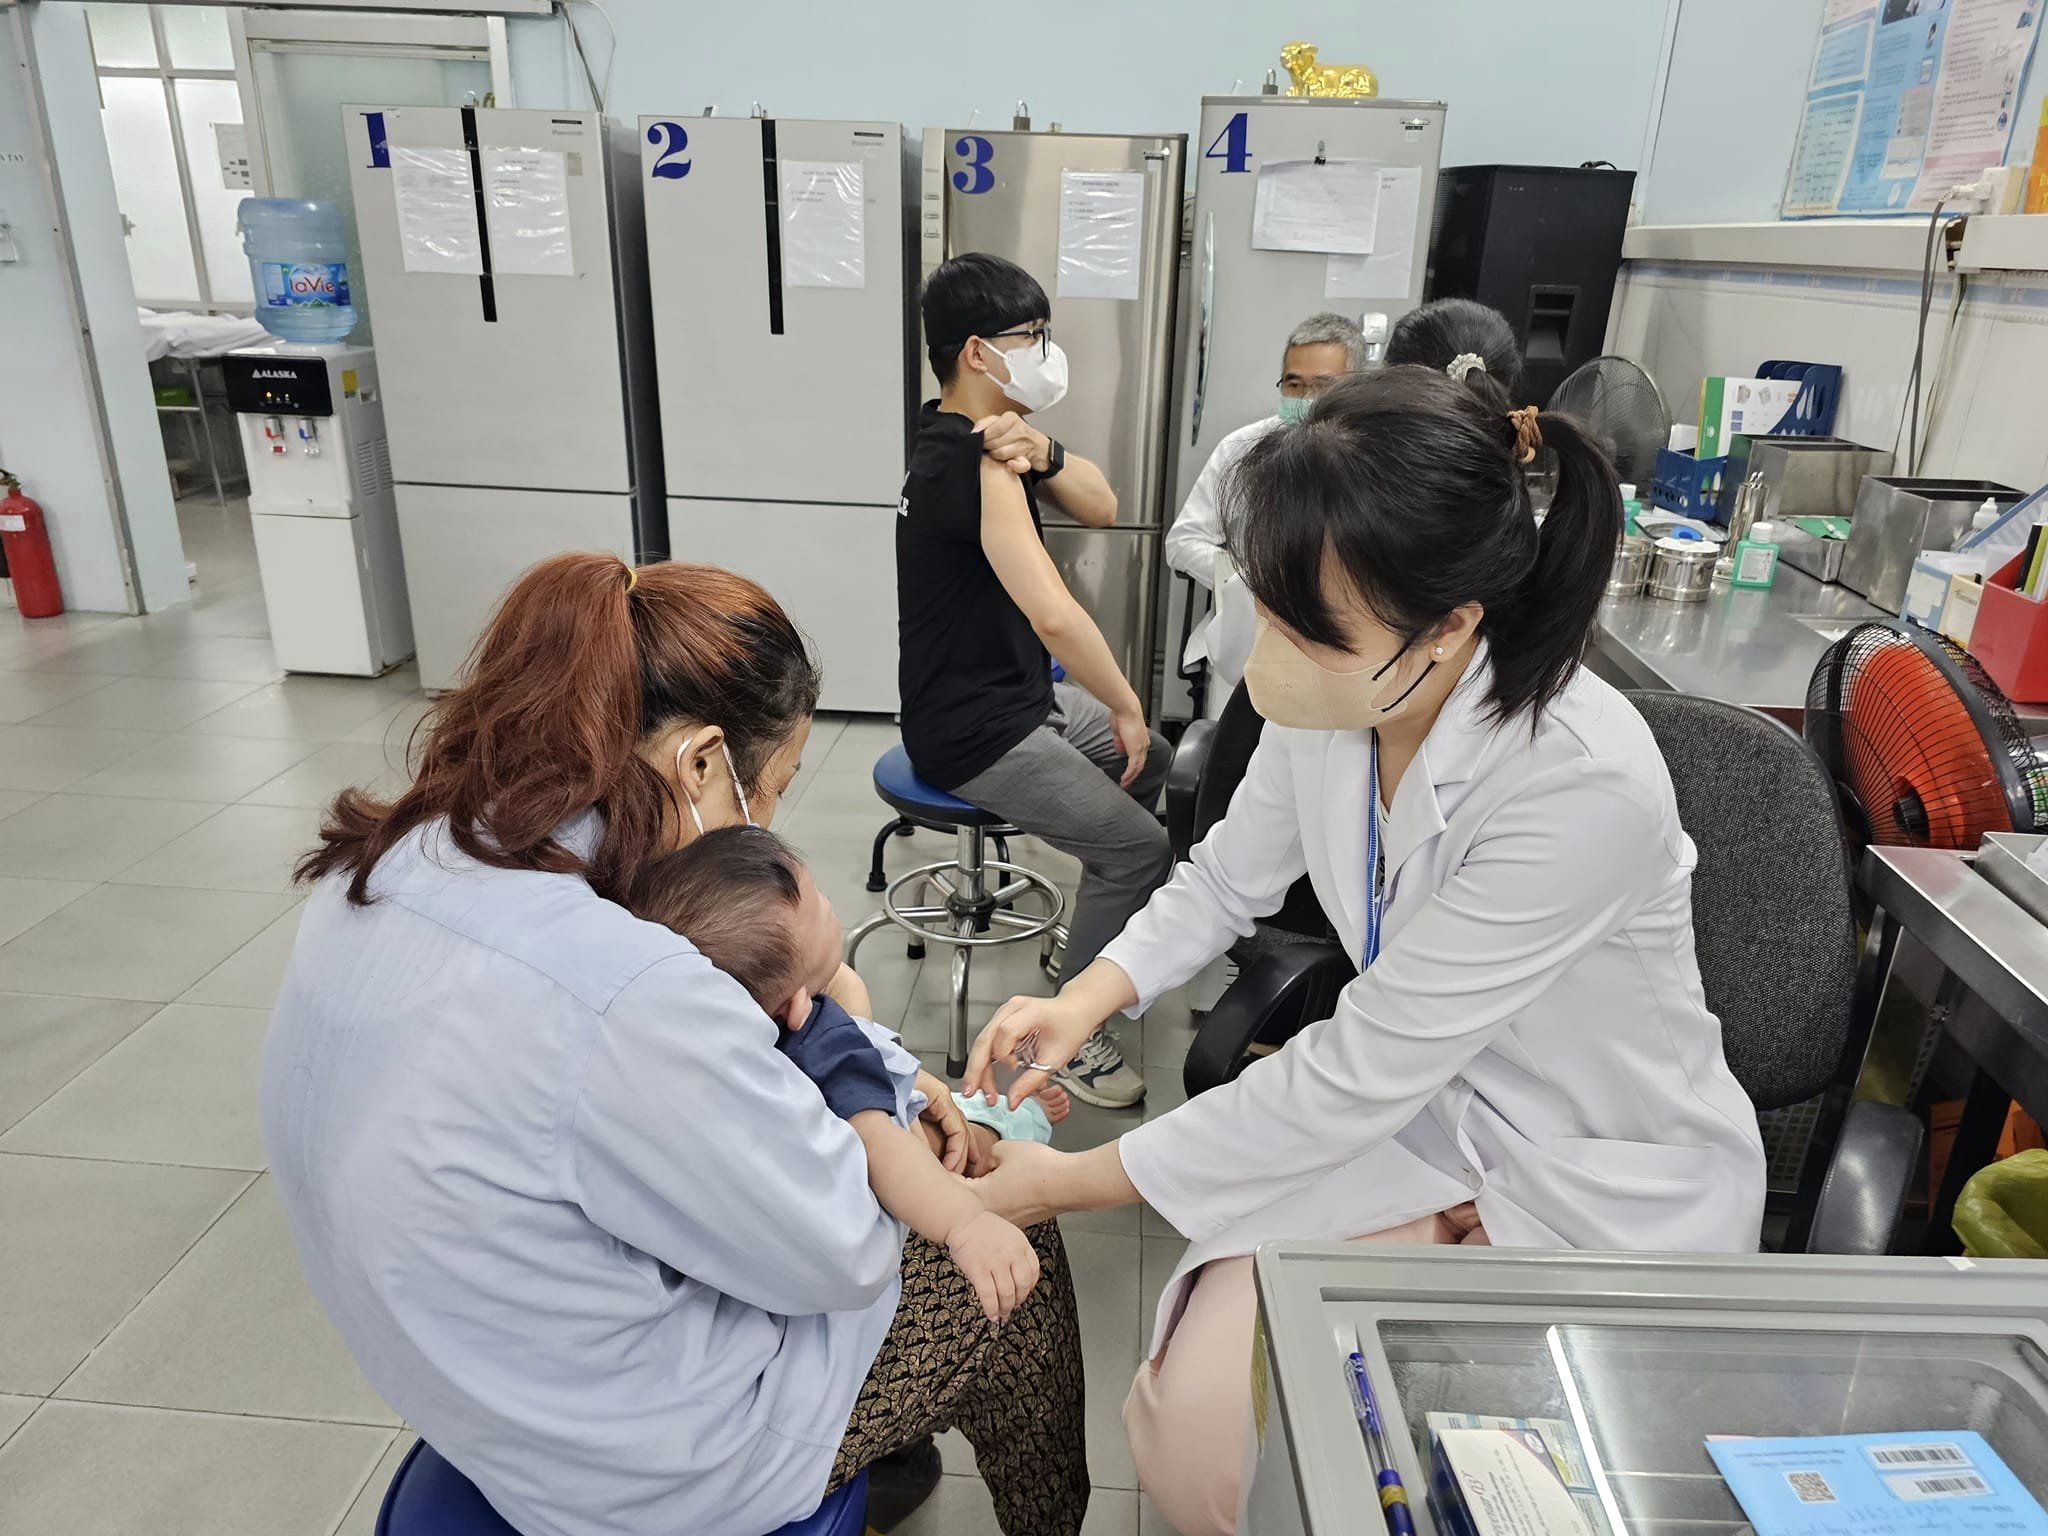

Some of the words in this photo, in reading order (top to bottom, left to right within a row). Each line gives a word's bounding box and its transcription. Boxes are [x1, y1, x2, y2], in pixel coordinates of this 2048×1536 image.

[360, 112, 391, 168] 1
[646, 121, 692, 179] 2
[952, 135, 996, 195] 3
[1205, 112, 1253, 174] 4
[261, 369, 298, 379] ALASKA
